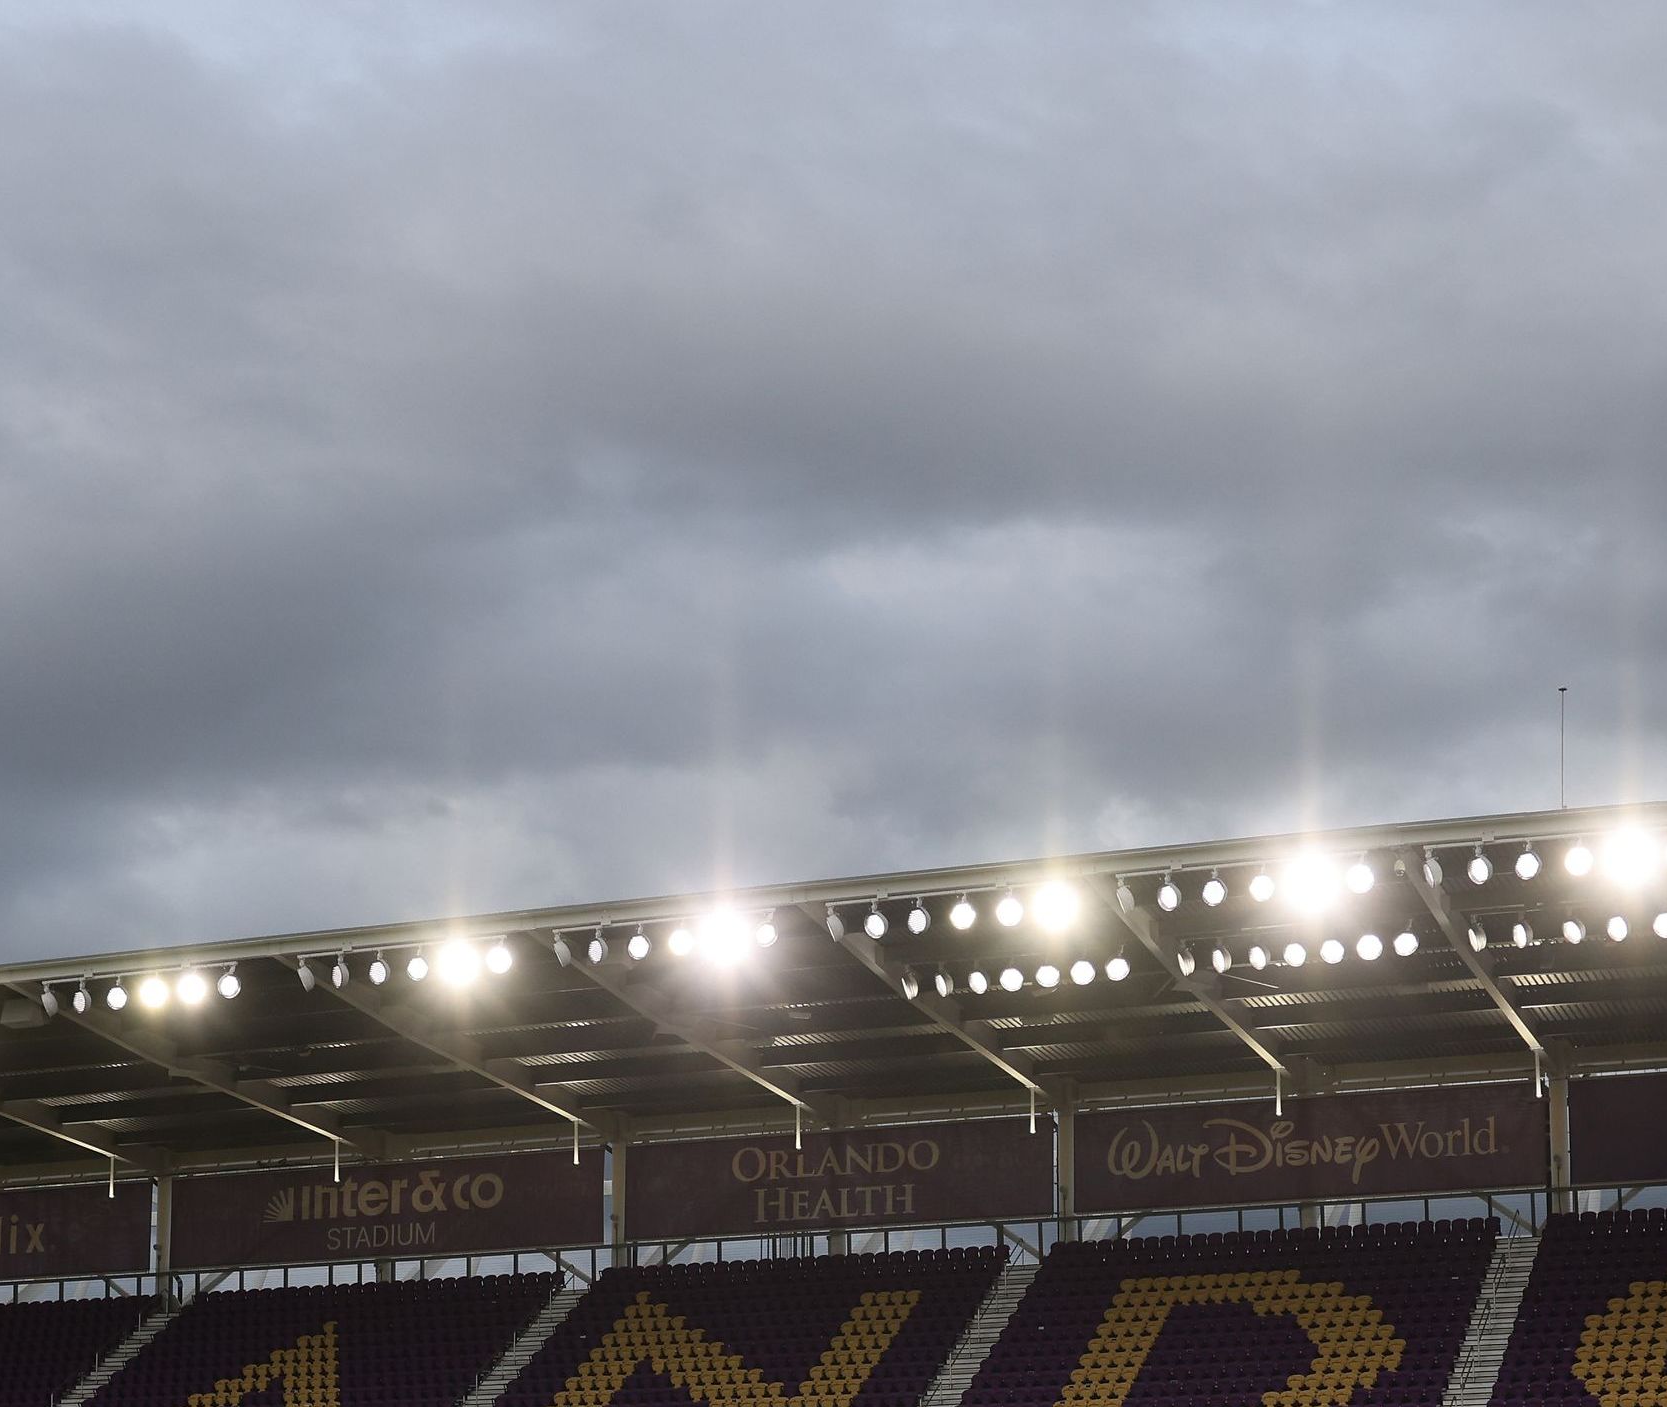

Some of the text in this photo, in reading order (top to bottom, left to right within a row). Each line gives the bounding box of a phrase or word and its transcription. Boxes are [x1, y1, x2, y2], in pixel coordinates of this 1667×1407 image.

[1379, 1115, 1498, 1158] World
[733, 1140, 939, 1184] ORLANDO
[298, 1168, 504, 1219] inter&co
[756, 1183, 916, 1225] HEALTH
[327, 1221, 436, 1251] STADIUM
